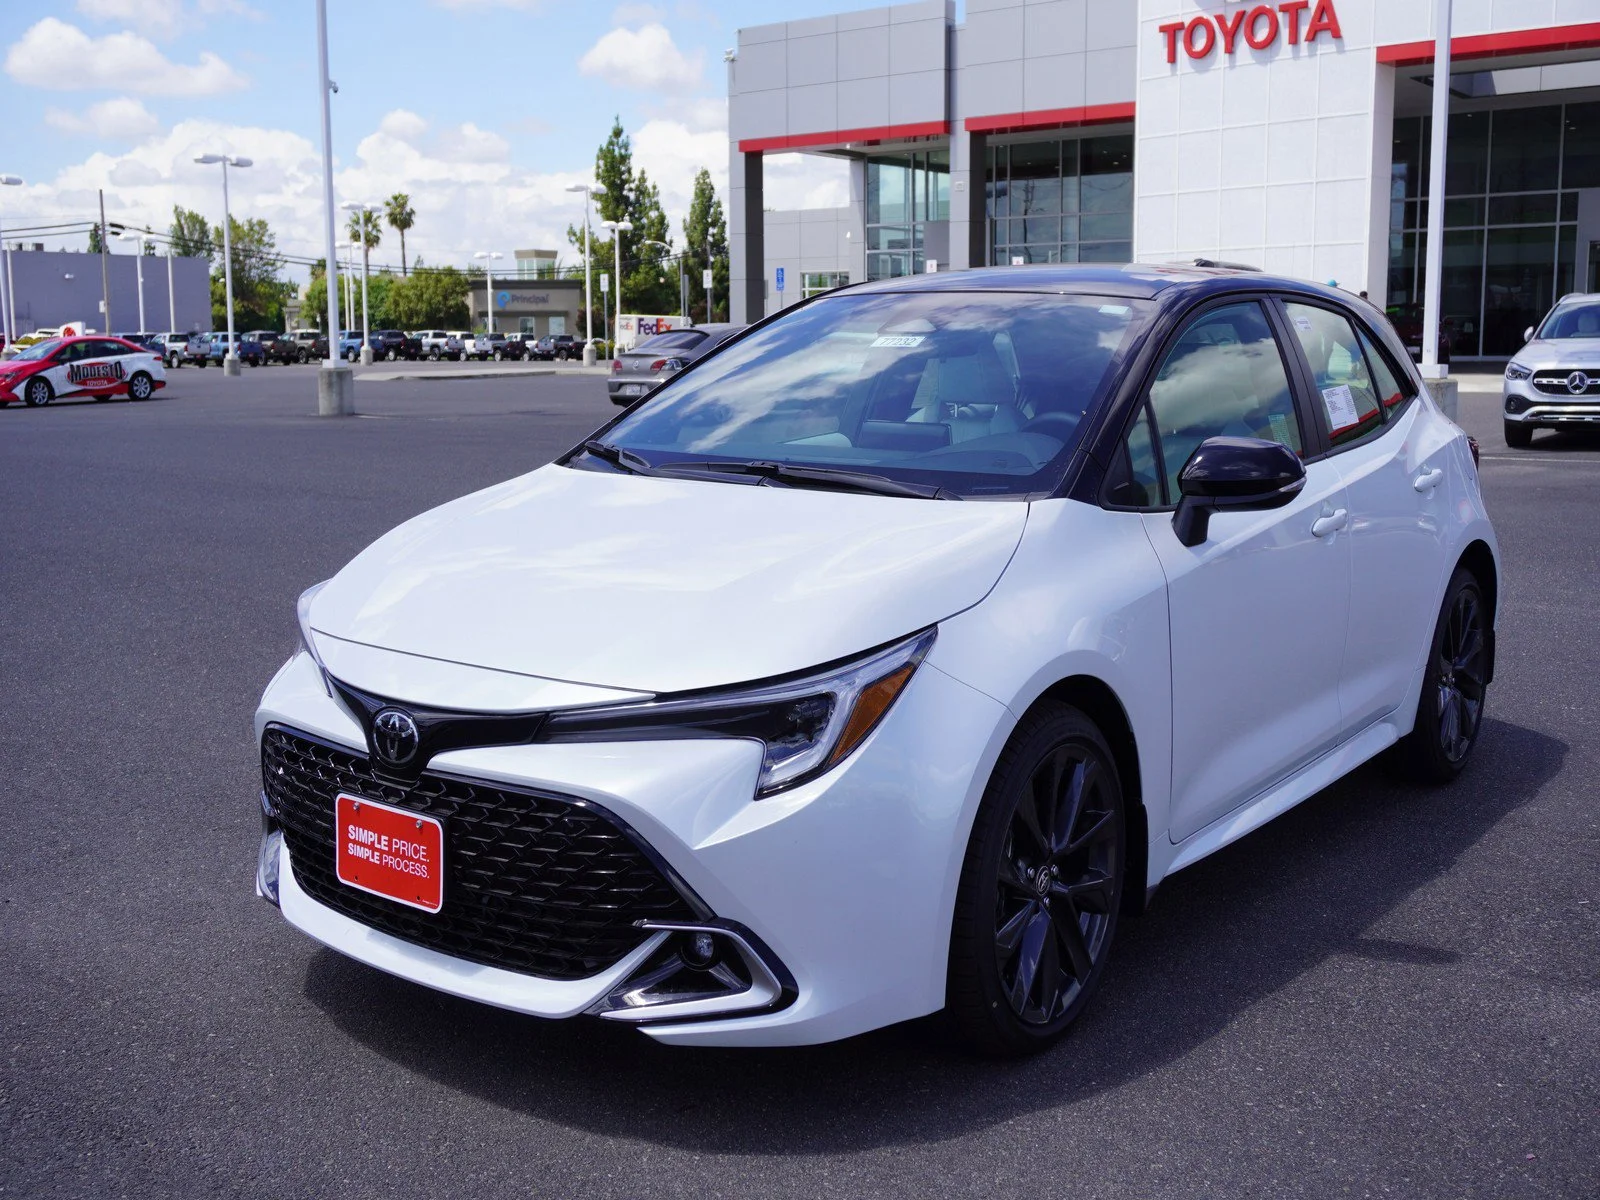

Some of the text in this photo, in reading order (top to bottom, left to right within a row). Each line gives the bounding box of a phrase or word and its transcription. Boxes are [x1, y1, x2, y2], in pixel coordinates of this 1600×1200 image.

[1158, 0, 1342, 64] TOYOTA
[511, 294, 549, 304] Principal
[880, 337, 917, 346] 77232
[86, 379, 108, 387] TOYOTA
[348, 824, 430, 863] SIMPLE PRICE.
[347, 842, 430, 879] SIMPLE PROCESS.
